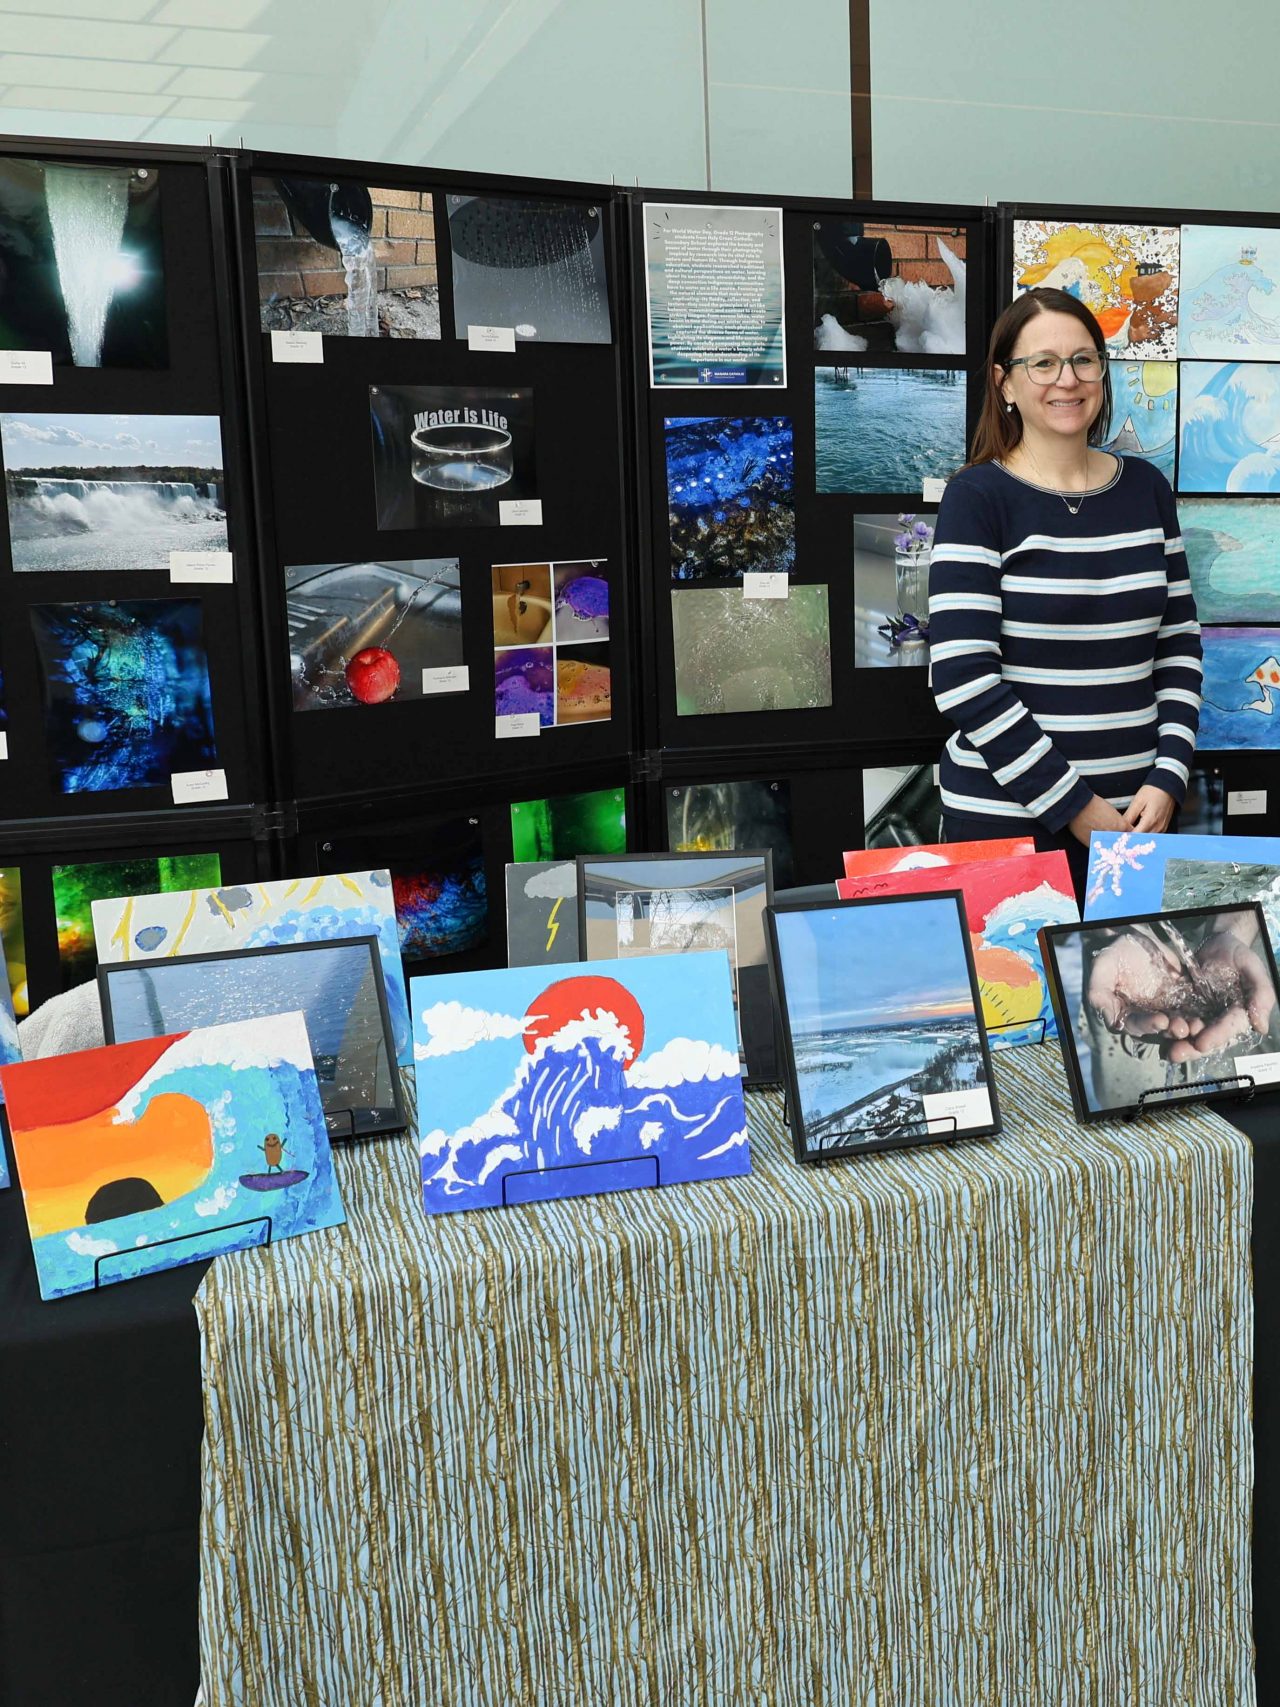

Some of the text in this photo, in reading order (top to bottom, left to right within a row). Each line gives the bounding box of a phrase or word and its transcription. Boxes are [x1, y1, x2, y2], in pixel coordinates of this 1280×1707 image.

[414, 407, 508, 430] Water is Life
